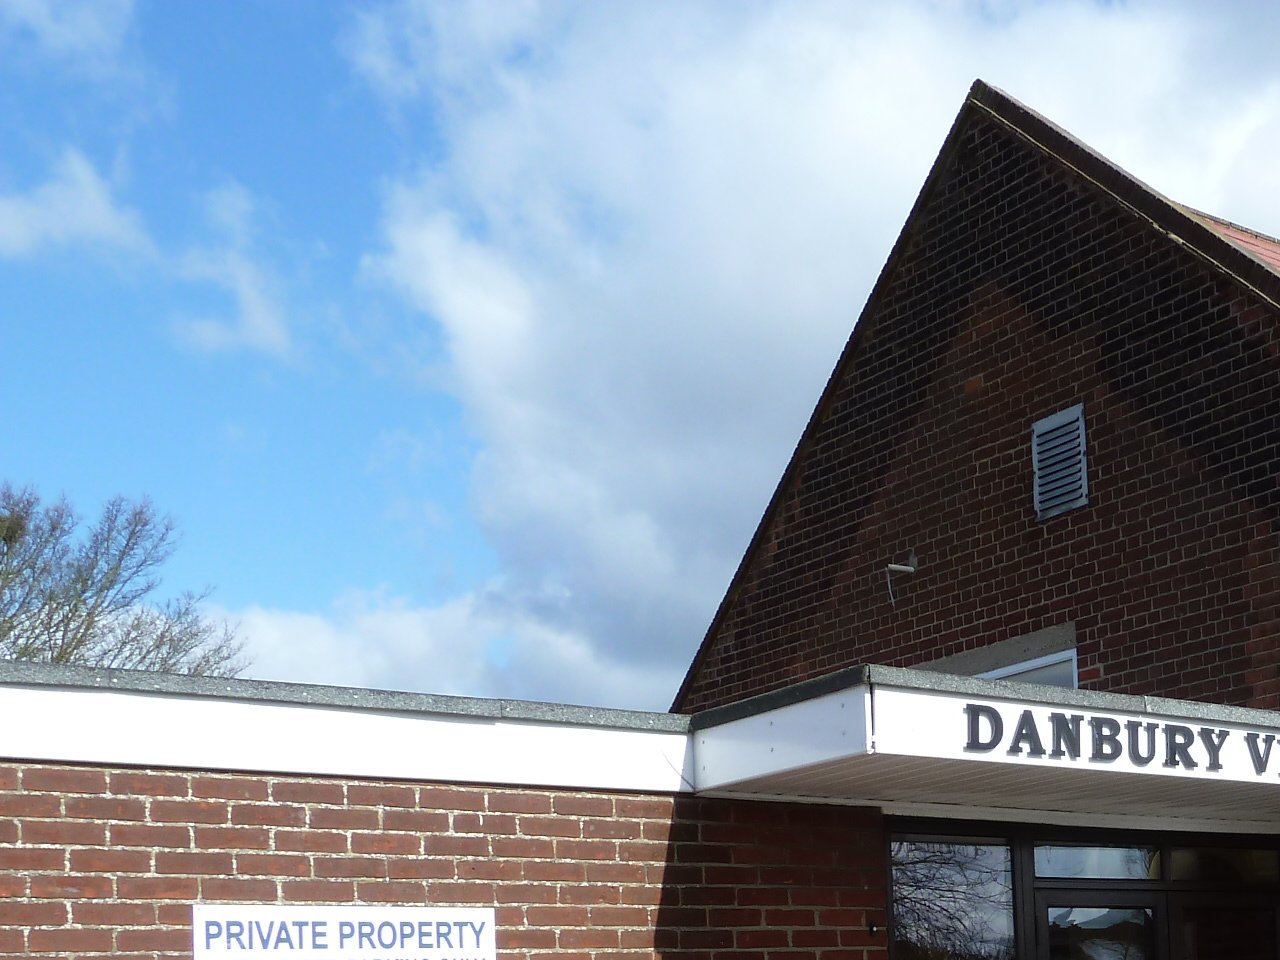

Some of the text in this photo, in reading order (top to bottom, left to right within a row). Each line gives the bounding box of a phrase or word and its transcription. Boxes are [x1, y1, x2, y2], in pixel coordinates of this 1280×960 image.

[962, 703, 1230, 771] DANBURY
[204, 920, 486, 949] PRIVATE PROPERTY
